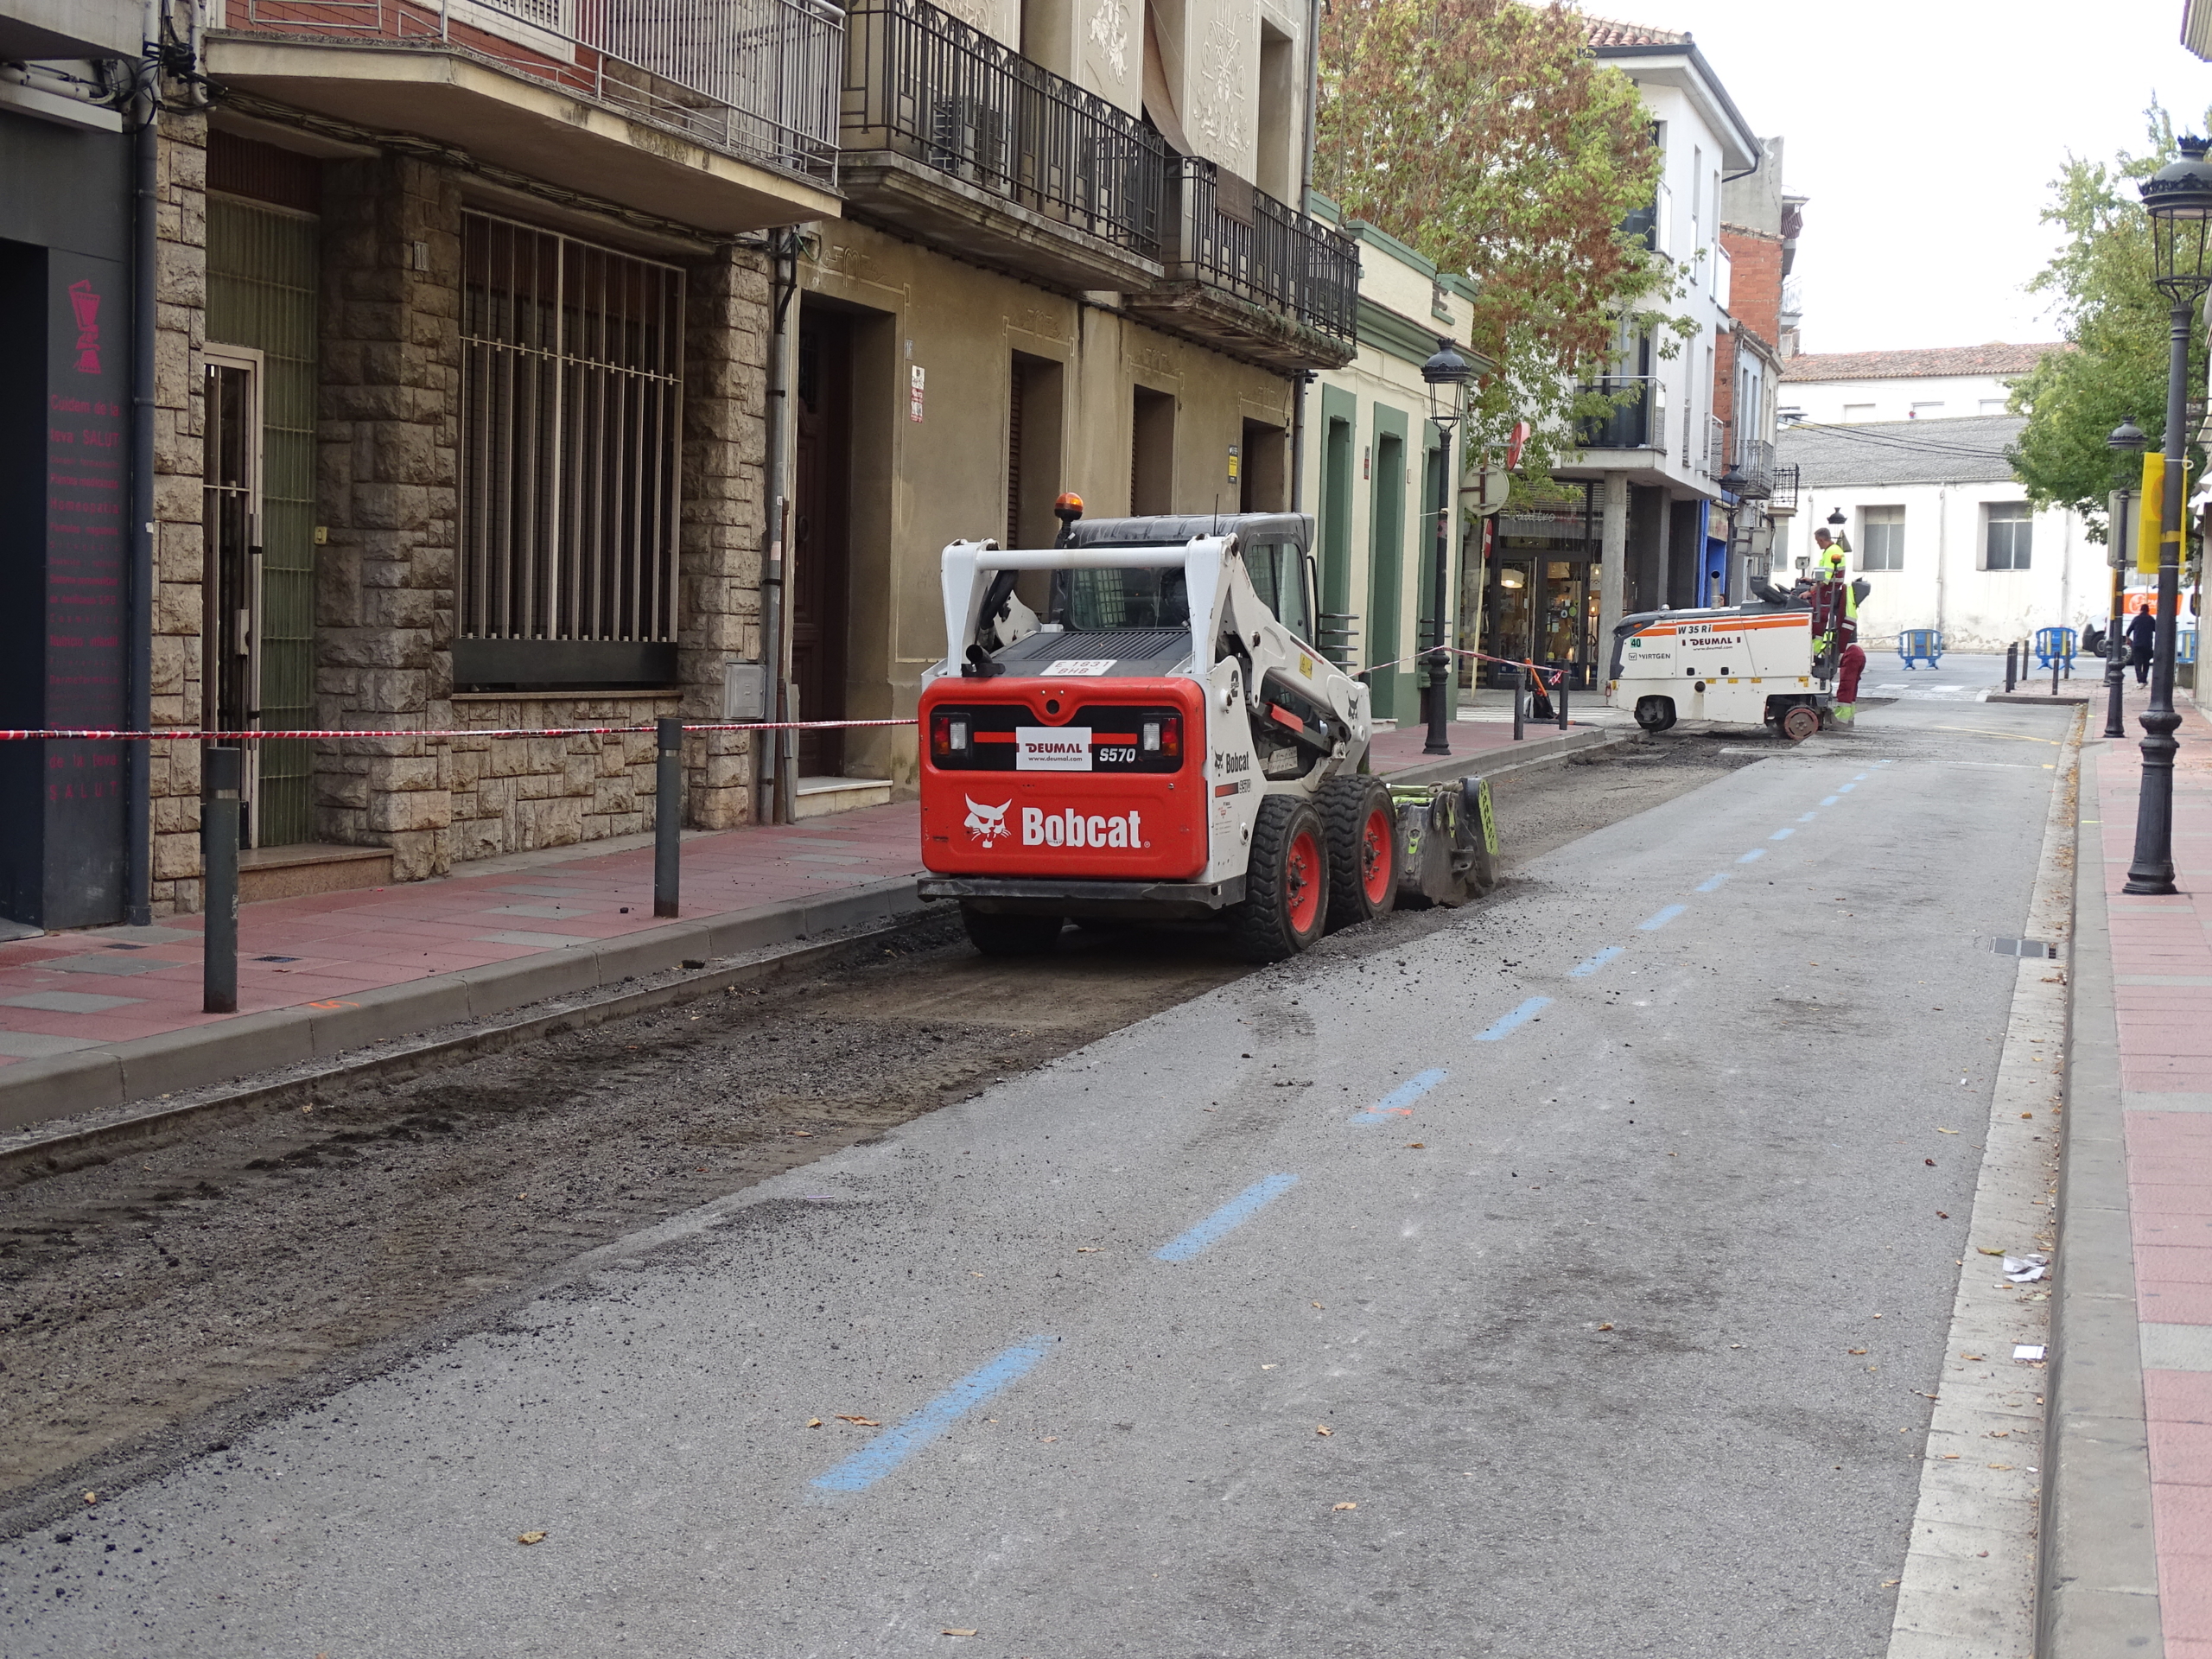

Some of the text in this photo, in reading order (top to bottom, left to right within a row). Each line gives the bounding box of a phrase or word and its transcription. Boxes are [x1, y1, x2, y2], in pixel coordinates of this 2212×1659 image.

[94, 399, 106, 415] de
[111, 401, 119, 416] la
[50, 428, 119, 447] teva SALUT
[1678, 626, 1687, 635] W
[1630, 639, 1641, 647] 40
[1690, 637, 1732, 646] DEUMAL
[1026, 743, 1082, 753] DEUMAL
[1099, 748, 1136, 762] S570
[49, 753, 118, 768] de la teva
[1226, 751, 1249, 774] Bobcat
[49, 780, 118, 800] SALUT
[1022, 807, 1141, 849] Bobcat
